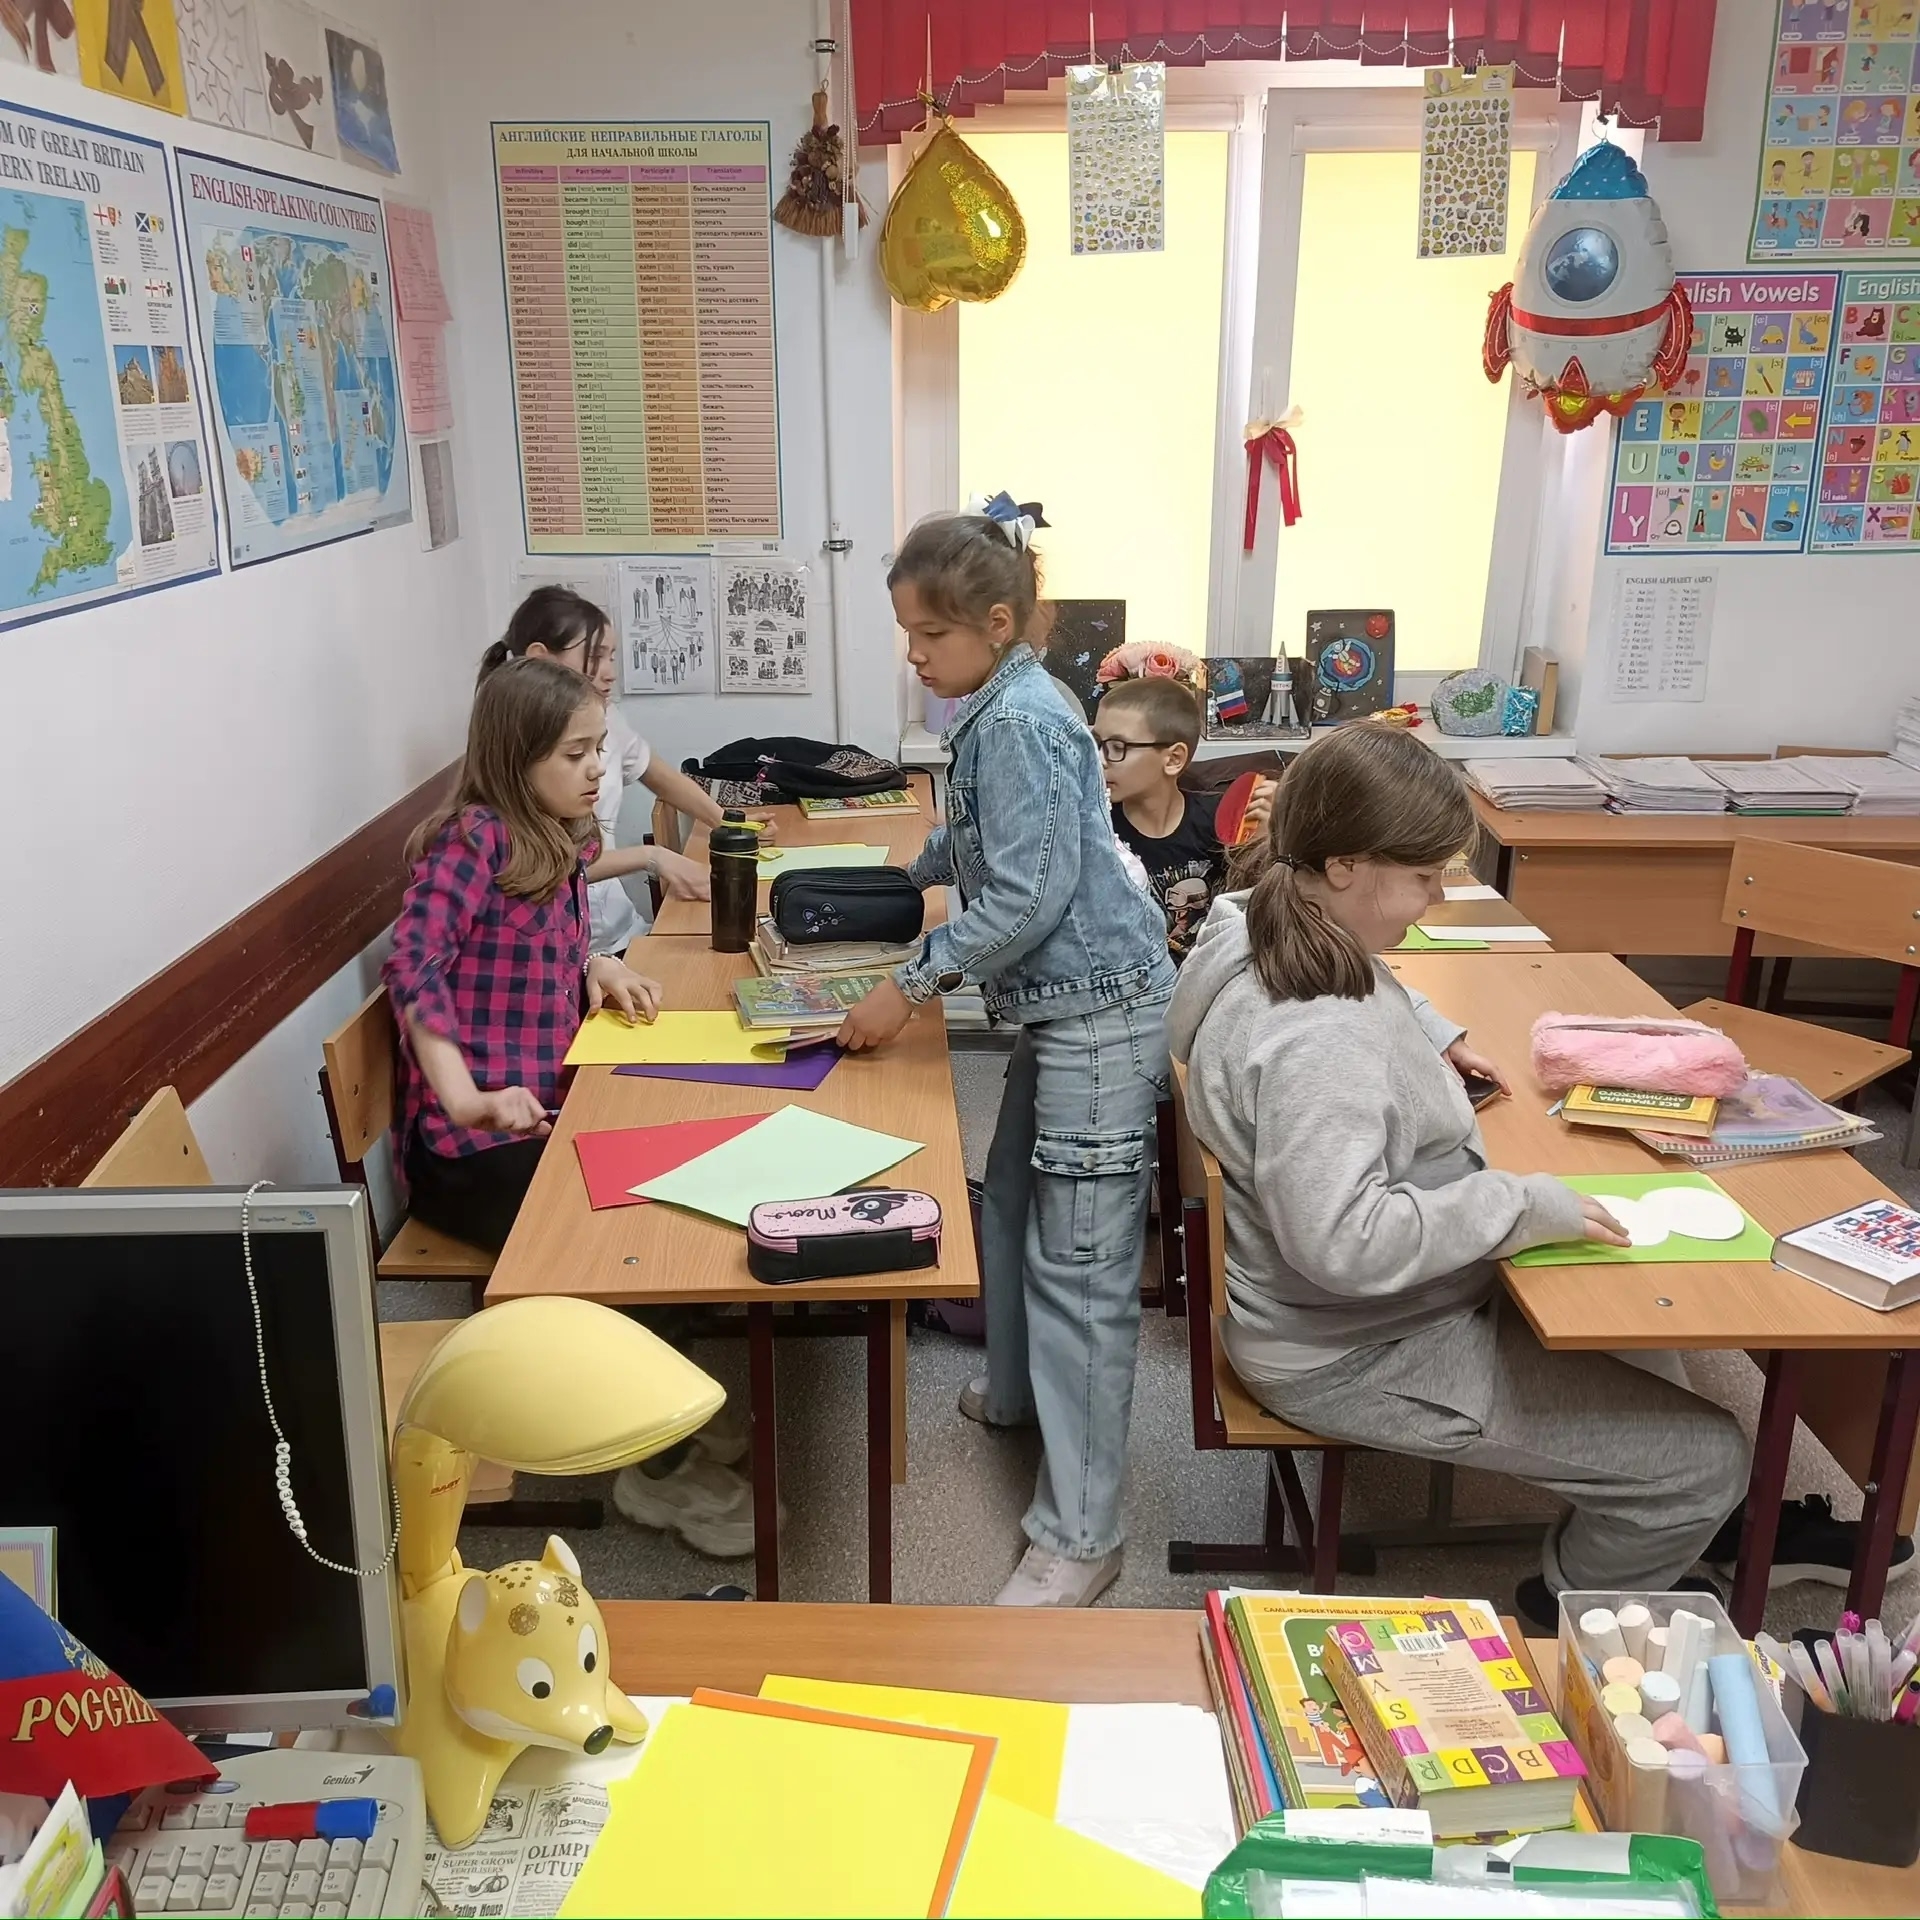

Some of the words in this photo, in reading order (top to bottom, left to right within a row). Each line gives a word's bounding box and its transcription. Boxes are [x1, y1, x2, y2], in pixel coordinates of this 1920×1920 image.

[499, 128, 587, 142] АНГЛИЙСКИЕ
[591, 130, 698, 142] НЕПРАВИЛЬНЫЕ
[701, 130, 763, 142] ГЛАГОЛЫ
[18, 124, 37, 149] OF
[41, 129, 89, 163] GREAT
[91, 142, 146, 174] BRITAIN
[566, 148, 588, 159] ДЛЯ
[591, 146, 655, 158] НАЧАЛЬНОЙ
[658, 147, 698, 158] ШКОЛЫ
[36, 160, 101, 194] IRELAND
[189, 172, 318, 223] ENGLISH-SPEAKING
[318, 200, 377, 234] COUNTRIES
[1740, 280, 1820, 304] Vowels
[1857, 278, 1920, 300] English
[1845, 306, 1858, 324] B
[1840, 348, 1851, 365] F
[1890, 347, 1907, 364] G
[1884, 388, 1898, 404] K
[1635, 409, 1649, 432] E
[1829, 429, 1844, 445] N
[1880, 428, 1892, 445] P
[1628, 452, 1648, 475] U
[1872, 467, 1886, 484] S
[1867, 506, 1881, 523] X
[1599, 1096, 1657, 1106] ПРАВИЛА
[1263, 1606, 1294, 1614] САМЫЕ
[1296, 1607, 1359, 1615] ЭФФЕКТИВНЫЕ
[1361, 1608, 1408, 1616] МЕТОДИКИ
[1498, 1666, 1520, 1682] R
[1515, 1690, 1538, 1709] Z
[11, 1685, 159, 1742] РОССИЯ
[1389, 1703, 1407, 1720] S
[1530, 1720, 1554, 1737] K
[1452, 1757, 1477, 1775] D
[1481, 1753, 1509, 1775] C
[1517, 1749, 1543, 1768] B
[323, 1774, 357, 1785] Genius
[442, 1859, 478, 1868] SUPER
[480, 1857, 517, 1866] GROW
[259, 1874, 267, 1883] 7
[292, 1872, 300, 1882] 8
[327, 1872, 335, 1881] 9
[479, 1903, 504, 1917] House
